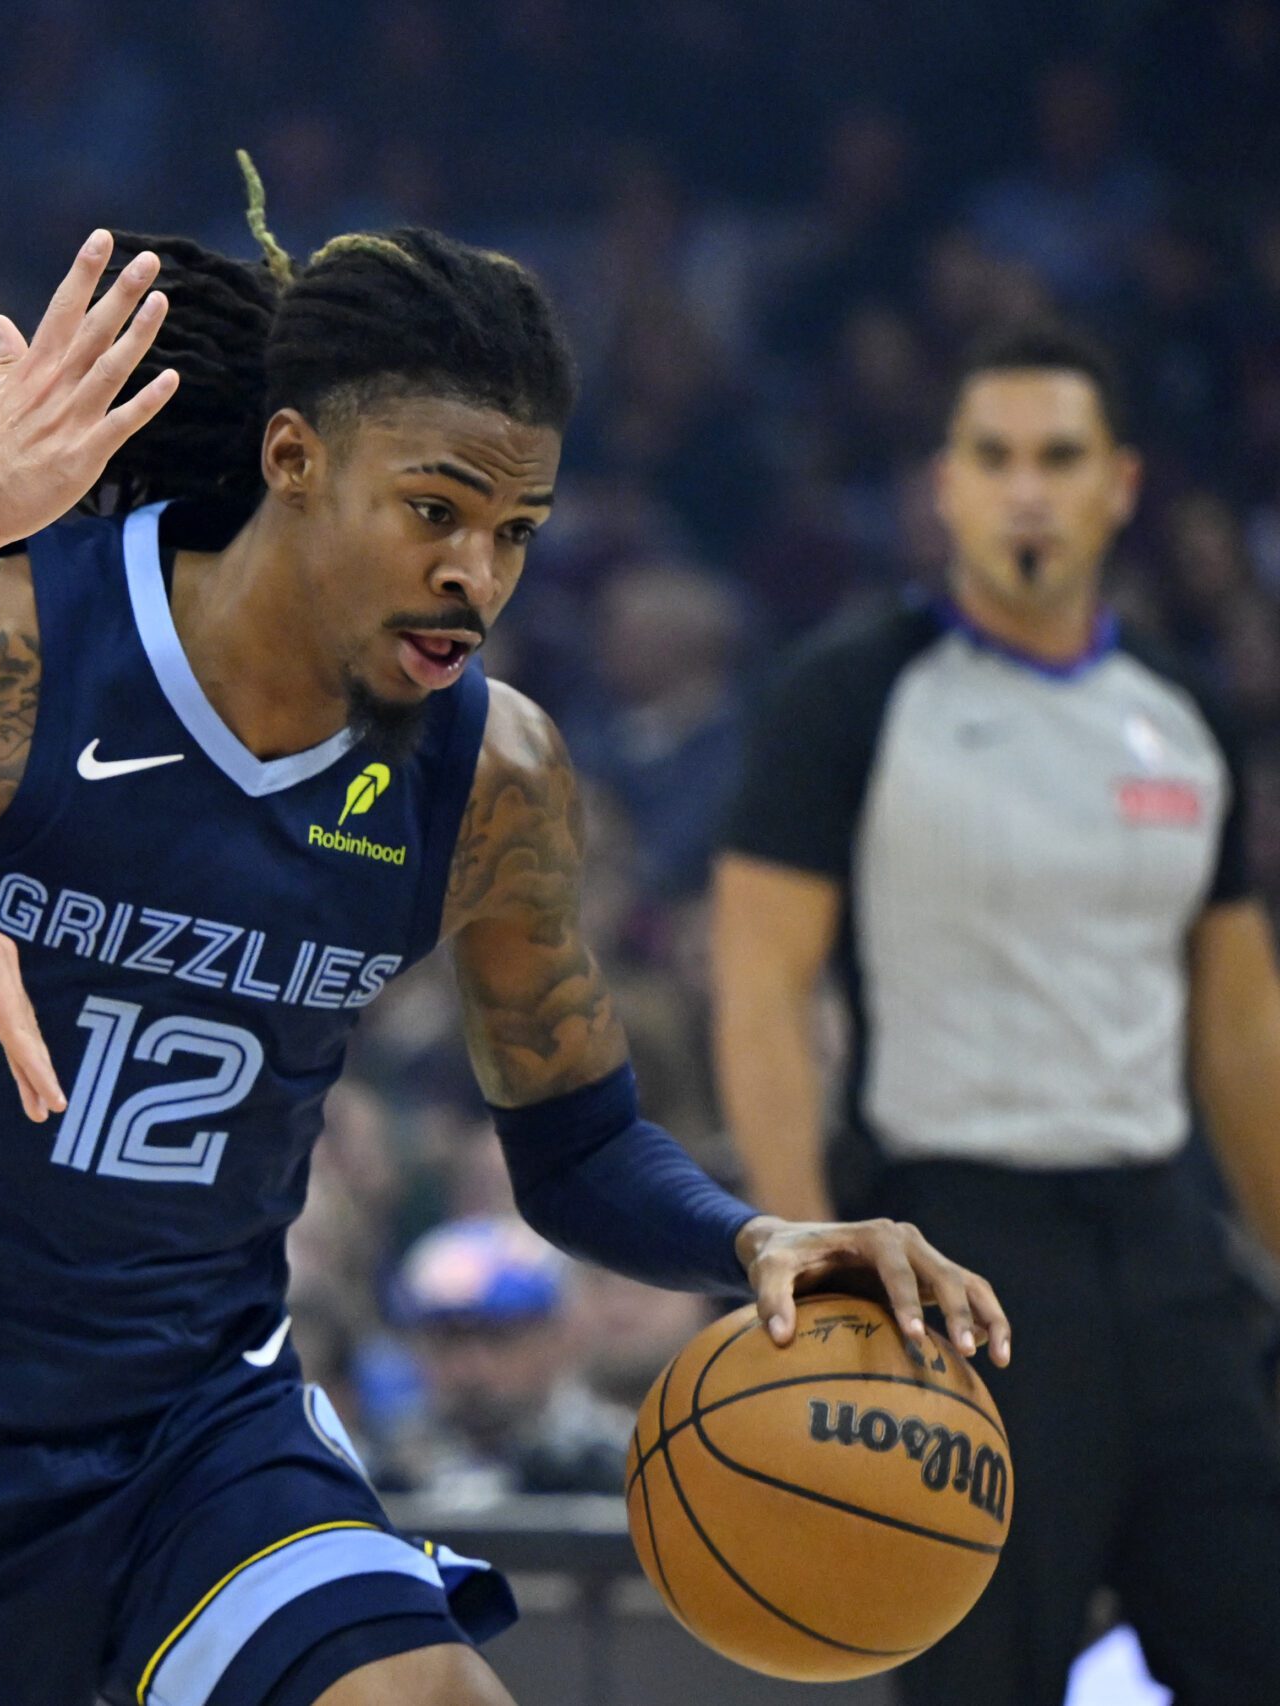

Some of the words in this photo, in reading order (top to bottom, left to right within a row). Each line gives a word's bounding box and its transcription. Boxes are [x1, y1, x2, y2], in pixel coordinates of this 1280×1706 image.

[308, 825, 406, 865] Robinhood
[50, 995, 264, 1186] 12
[808, 1397, 1008, 1526] Wilson
